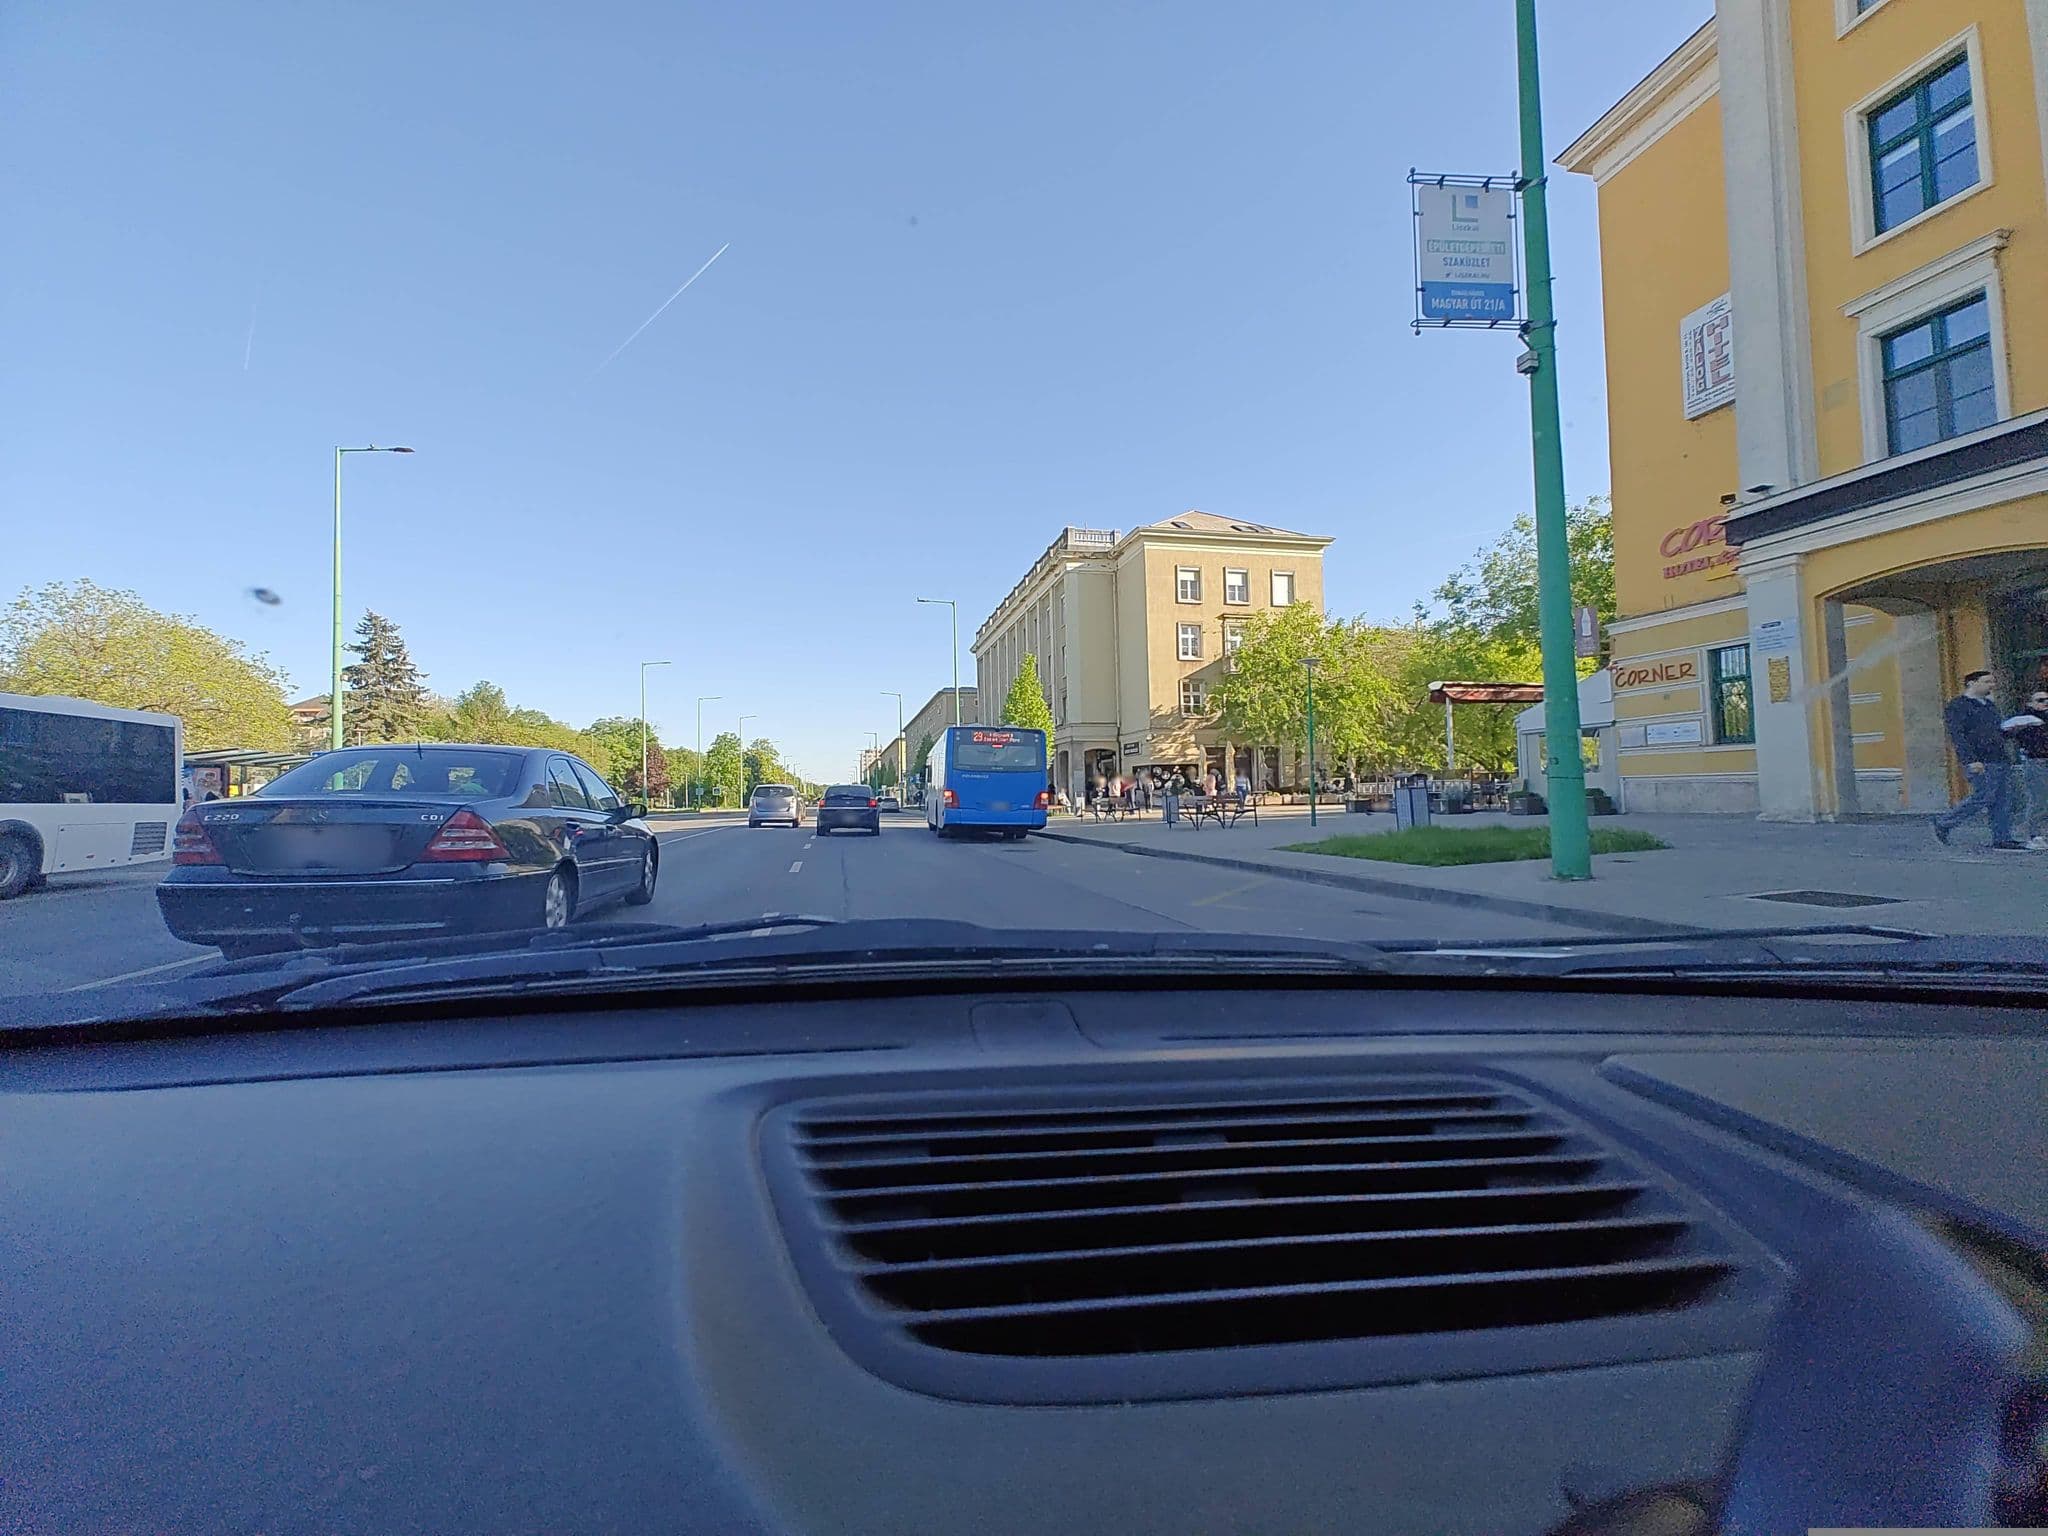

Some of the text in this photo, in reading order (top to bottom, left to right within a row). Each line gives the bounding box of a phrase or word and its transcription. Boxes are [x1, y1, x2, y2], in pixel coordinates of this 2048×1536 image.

[1442, 255, 1490, 268] SZAKÜZLET
[1431, 296, 1506, 312] MAGYAR ÚT 21/A
[1706, 316, 1730, 385] HITEL
[1615, 662, 1696, 688] CORNER
[421, 813, 444, 822] CDI
